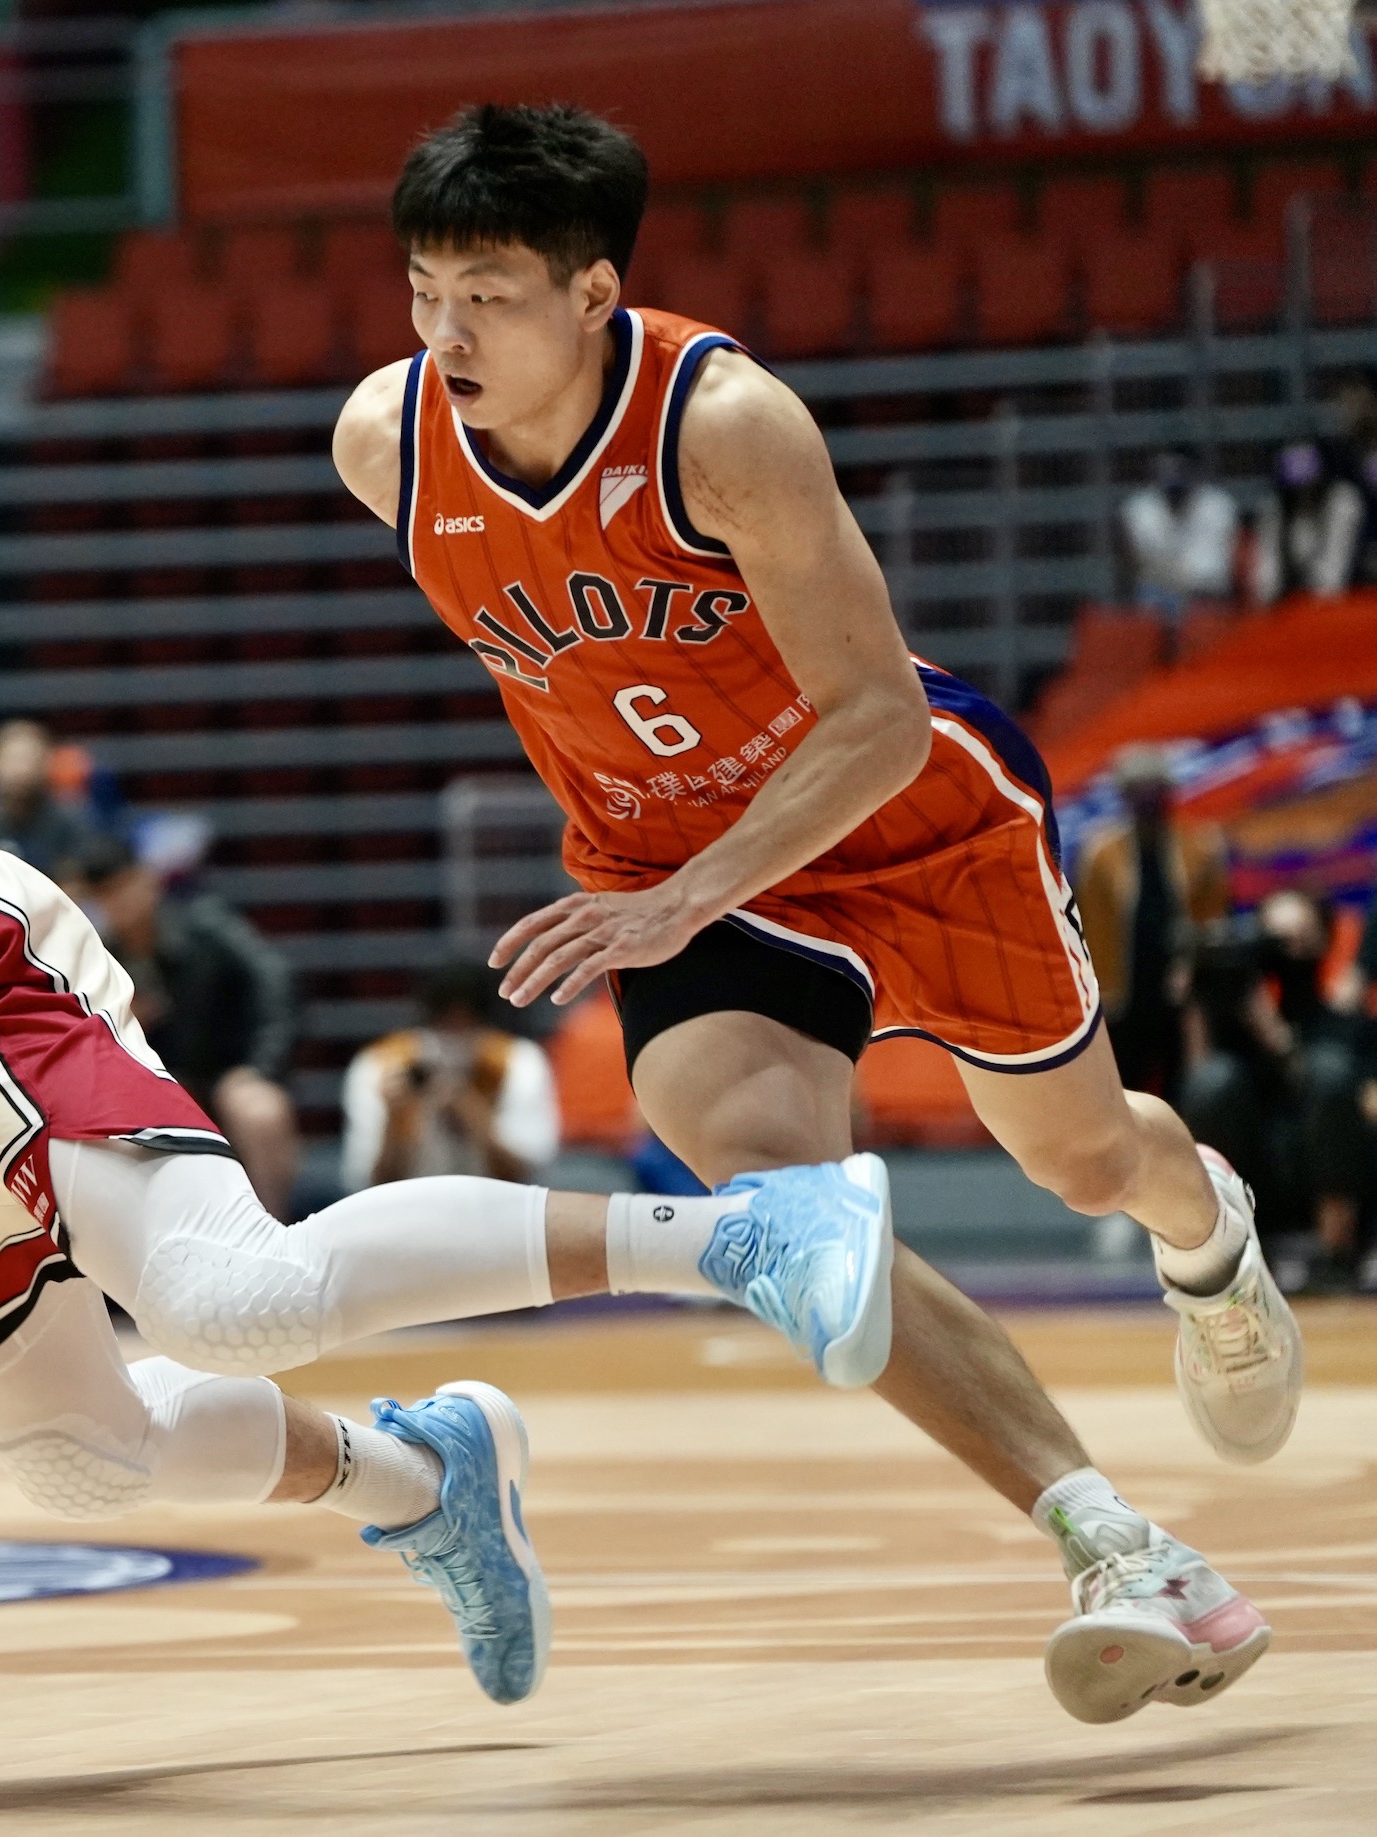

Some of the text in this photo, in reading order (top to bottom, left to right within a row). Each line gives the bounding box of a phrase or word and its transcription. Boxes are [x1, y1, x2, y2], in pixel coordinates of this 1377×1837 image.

[919, 0, 1377, 143] TAOY
[602, 465, 648, 478] DAIKI
[444, 515, 485, 534] asics
[468, 569, 751, 693] PILOTS
[613, 684, 702, 757] 6
